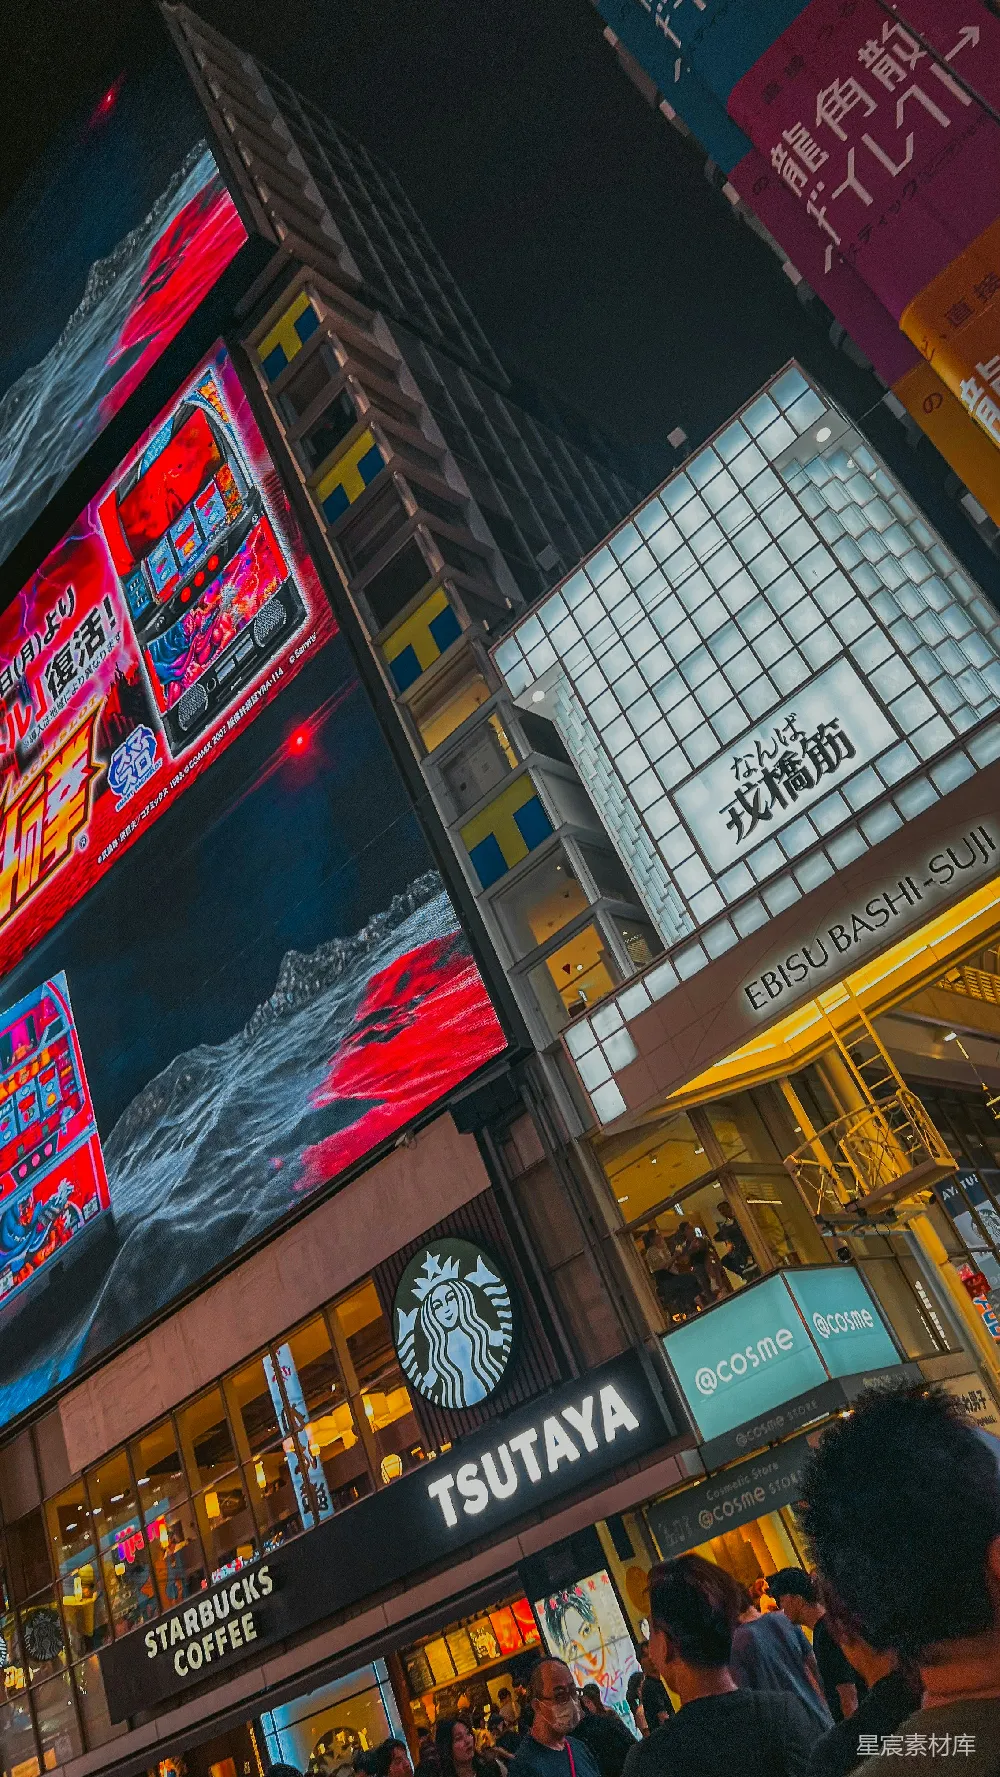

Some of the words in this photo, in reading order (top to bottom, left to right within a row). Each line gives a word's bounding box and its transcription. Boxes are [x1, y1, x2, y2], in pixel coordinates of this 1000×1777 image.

[718, 716, 858, 846] 戎橋筋
[730, 711, 807, 782] なんば
[742, 937, 830, 1012] EBISU
[811, 1306, 875, 1340] @cosme
[694, 1326, 795, 1396] @cosme
[426, 1383, 641, 1529] TSUTAYA
[698, 1486, 766, 1531] @cosme
[143, 1564, 275, 1660] STARBUCKS
[173, 1612, 258, 1678] COFFEE
